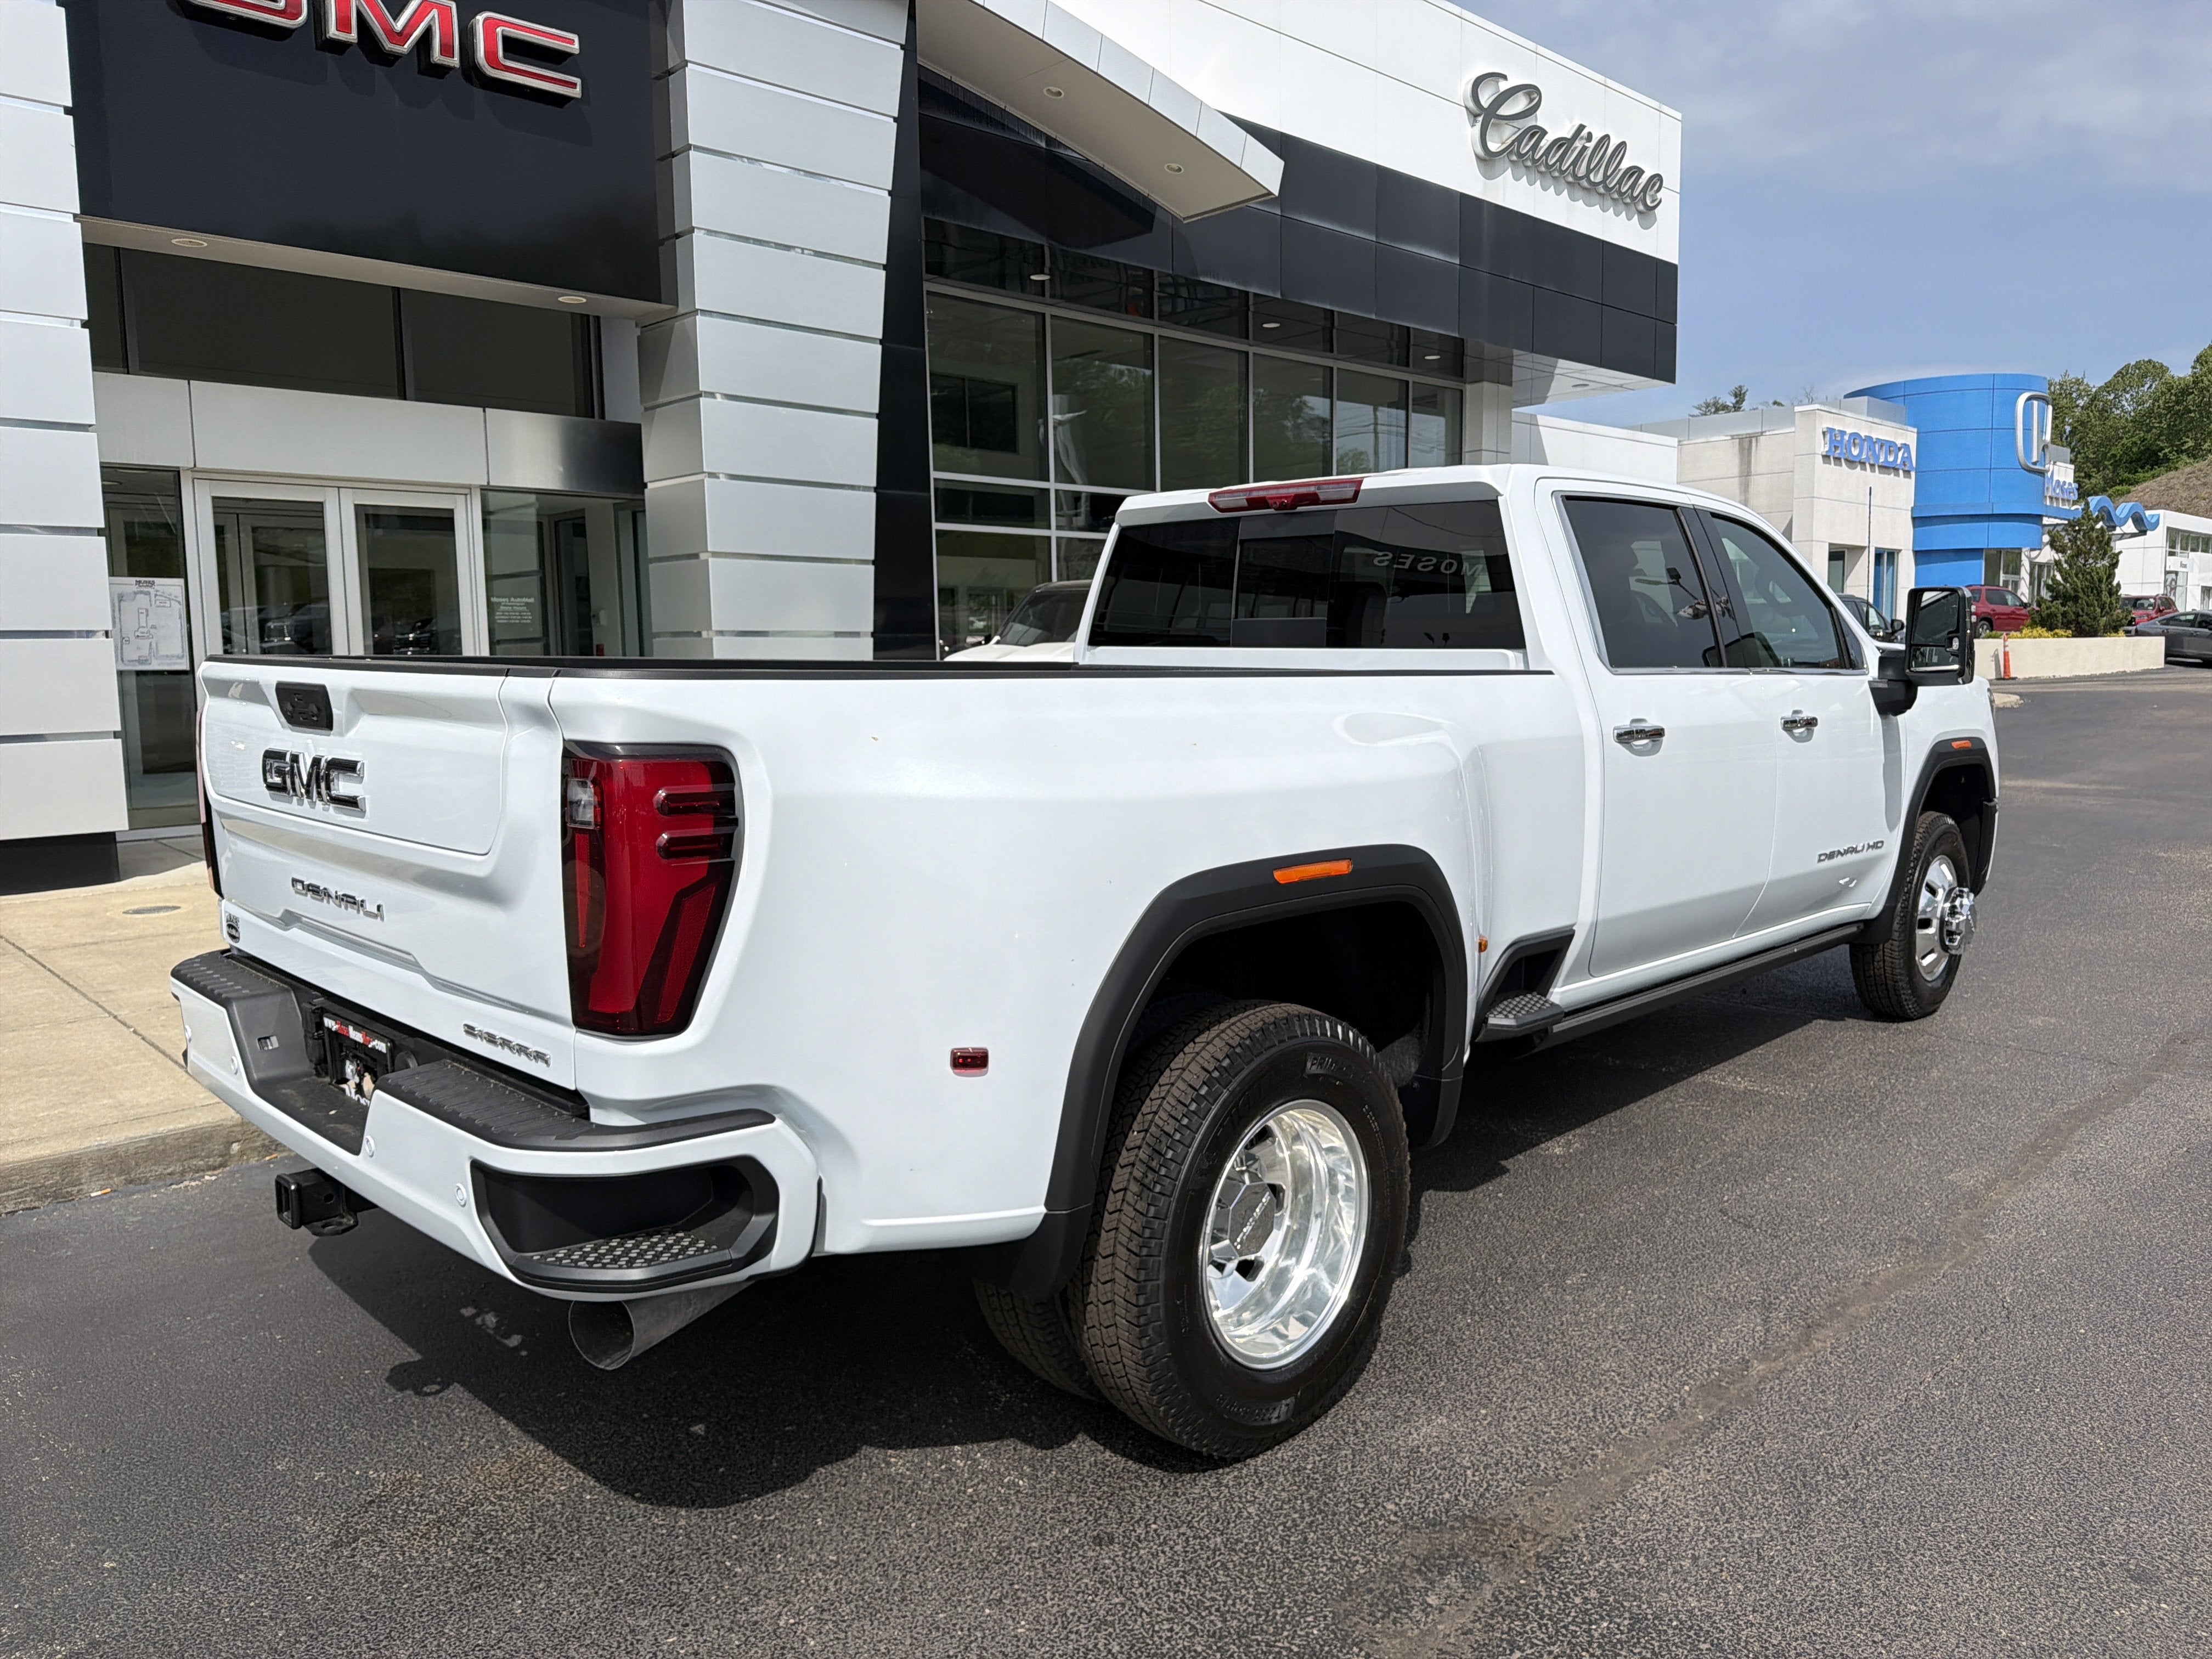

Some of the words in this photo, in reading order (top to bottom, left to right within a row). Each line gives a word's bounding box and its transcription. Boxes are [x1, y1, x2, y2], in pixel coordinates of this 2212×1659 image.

[1464, 72, 1664, 213] Cadillac
[1822, 427, 1915, 472] HONDA
[262, 748, 366, 812] GMC
[1817, 844, 1865, 864] DENALI
[1866, 840, 1884, 852] HD
[291, 877, 384, 922] DENALI
[463, 1023, 551, 1068] SIERRA
